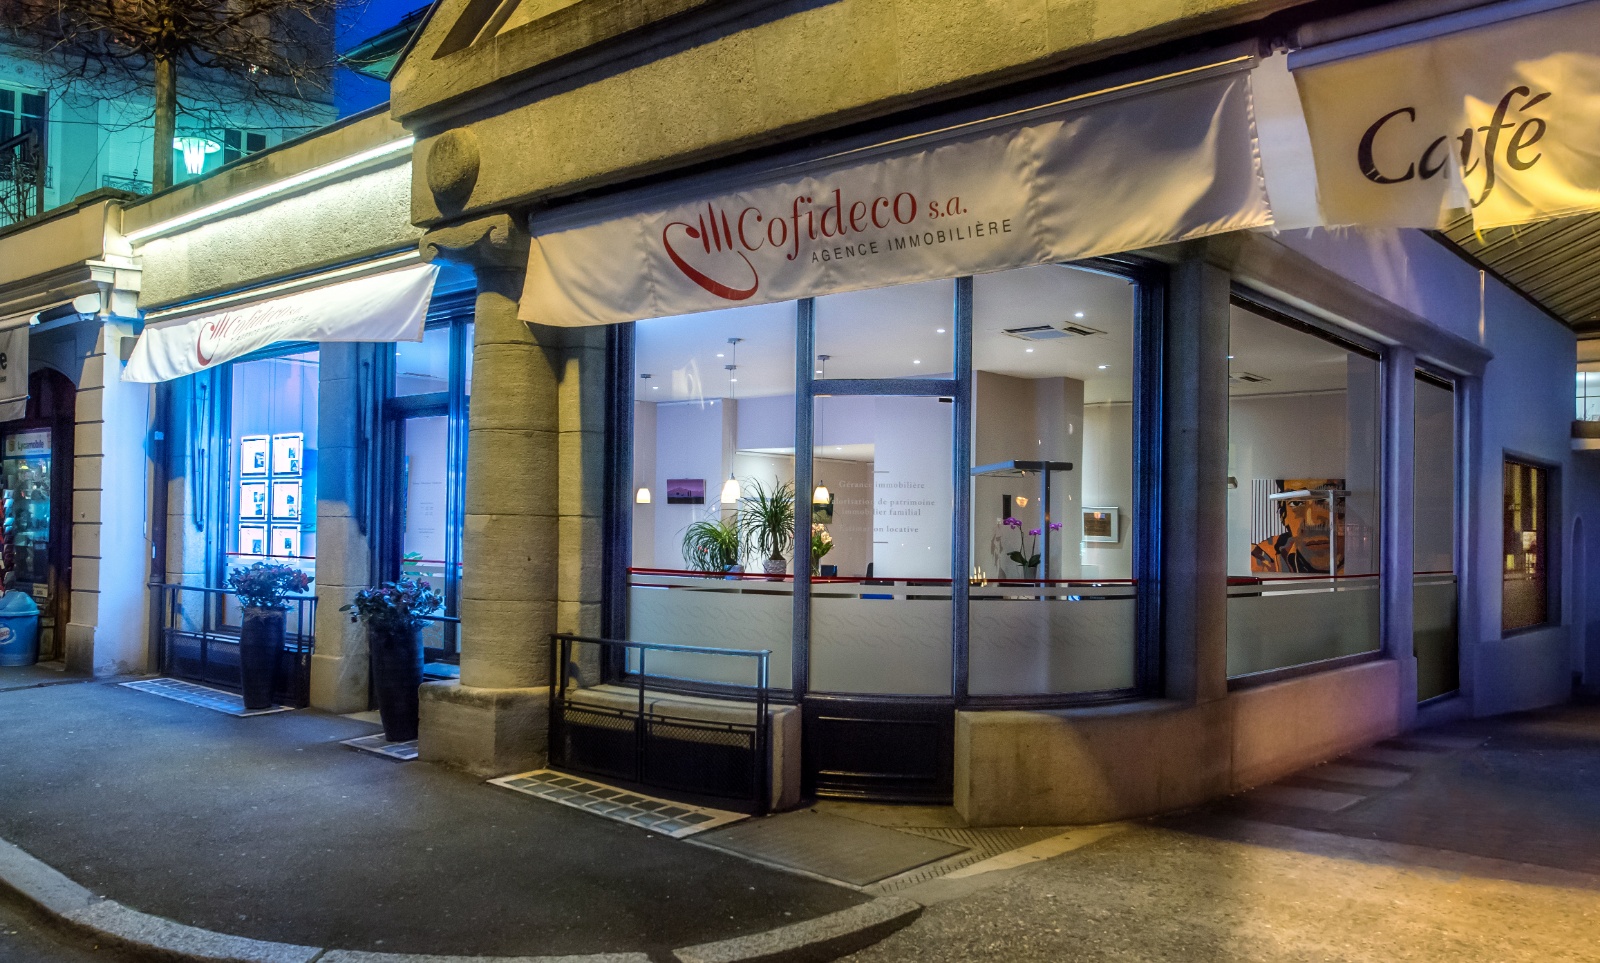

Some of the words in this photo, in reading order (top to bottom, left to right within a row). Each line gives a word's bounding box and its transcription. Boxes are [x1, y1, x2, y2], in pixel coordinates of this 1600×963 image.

[1358, 85, 1552, 208] Café
[737, 188, 917, 261] Cofideco
[928, 196, 968, 220] s.a.
[811, 241, 879, 264] AGENCE
[888, 218, 1012, 251] IMMOBILIÈRE
[875, 481, 926, 489] immobilière
[877, 497, 888, 505] de
[889, 498, 936, 507] patrimoine
[889, 507, 921, 516] familial
[886, 525, 919, 533] locative
